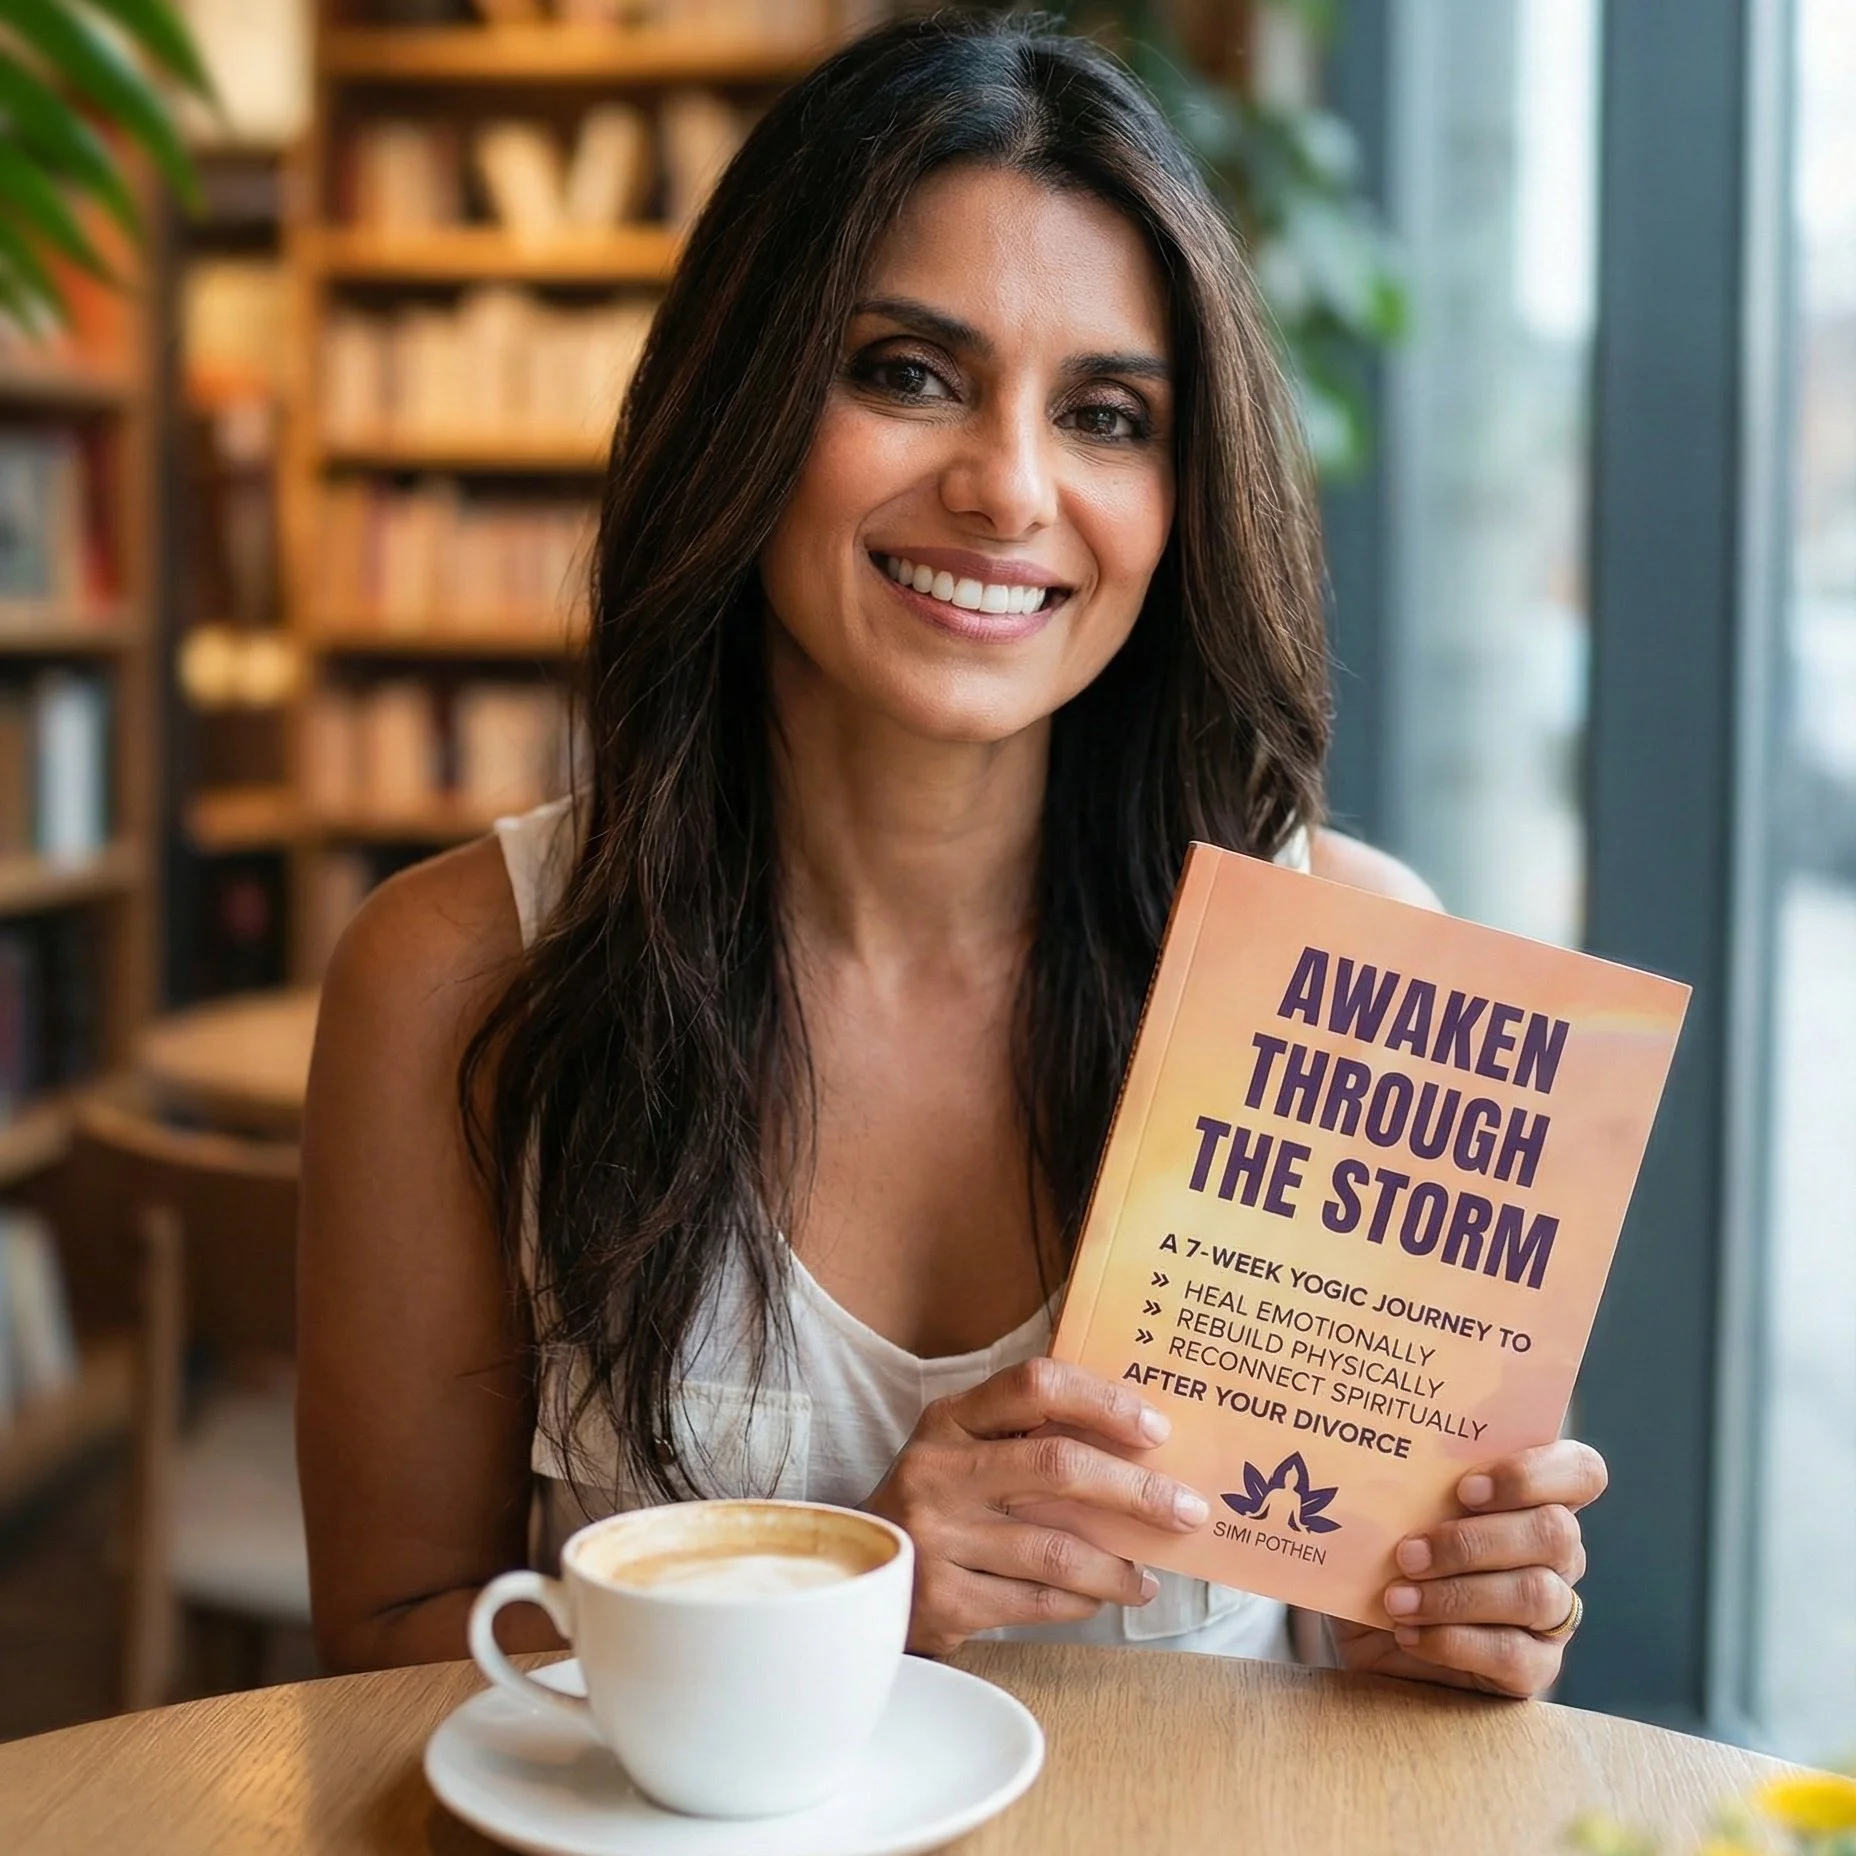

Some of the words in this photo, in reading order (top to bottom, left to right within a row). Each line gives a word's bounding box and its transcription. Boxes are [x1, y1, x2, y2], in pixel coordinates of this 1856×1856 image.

[1276, 946, 1570, 1094] AWAKEN
[1245, 1032, 1550, 1188] THROUGH
[1189, 1115, 1311, 1219] THE
[1322, 1158, 1560, 1290] STORM
[1159, 1233, 1178, 1254] A
[1186, 1238, 1282, 1283] 7-WEEK
[1290, 1268, 1368, 1306] YOGIC
[1372, 1295, 1492, 1341] JOURNEY
[1499, 1328, 1531, 1353] TO
[1184, 1280, 1248, 1316] HEAL
[1257, 1301, 1436, 1366] EMOTIONALLY
[1169, 1337, 1326, 1396] RECONNECT
[1330, 1382, 1488, 1441] SPIRITUALLY
[1176, 1308, 1284, 1354] REBUILD
[1291, 1340, 1445, 1398] PHYSICALLY
[1122, 1362, 1207, 1401] AFTER
[1216, 1387, 1287, 1424] YOUR
[1293, 1409, 1412, 1459] DIVORCE
[1213, 1521, 1251, 1545] SIMI
[1255, 1530, 1326, 1565] POTHEN
